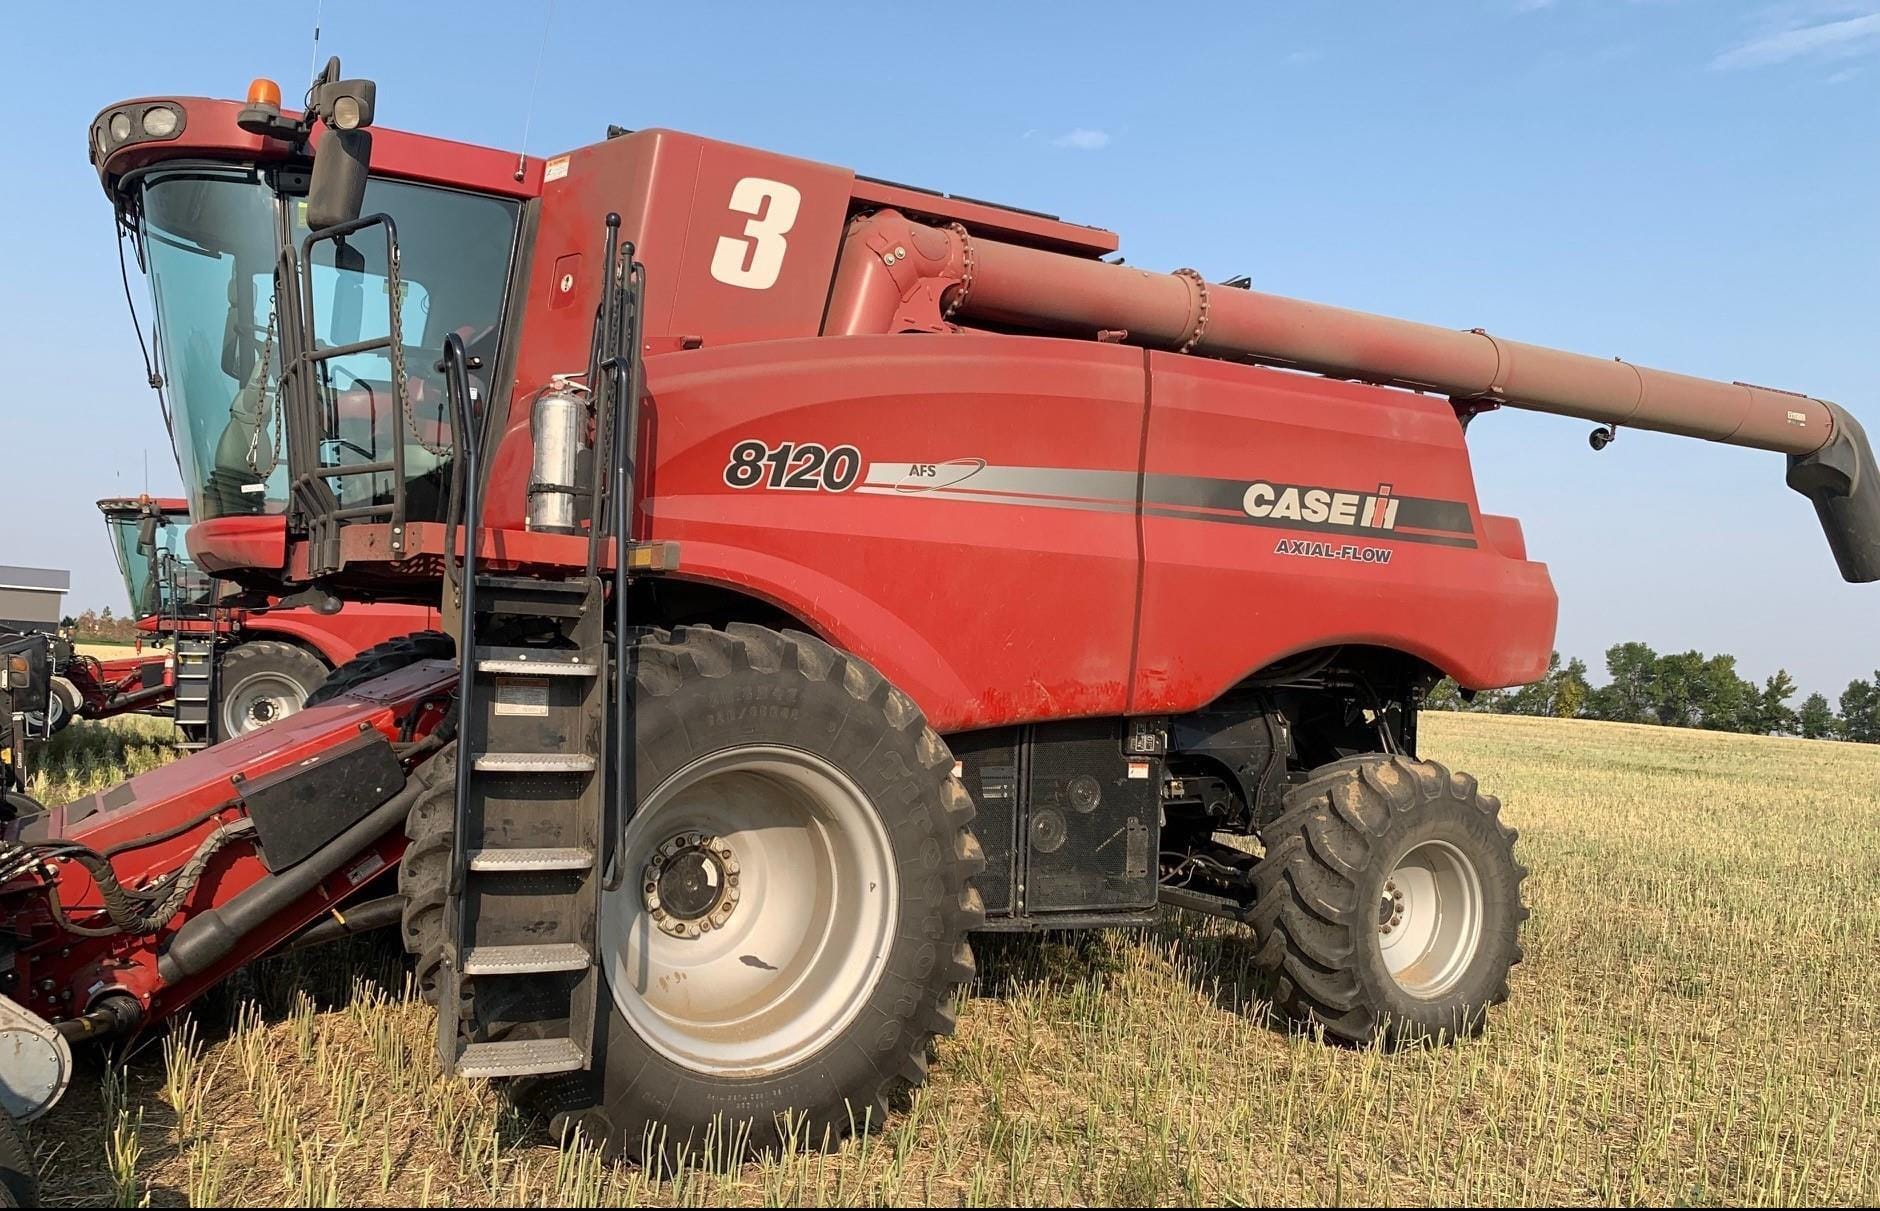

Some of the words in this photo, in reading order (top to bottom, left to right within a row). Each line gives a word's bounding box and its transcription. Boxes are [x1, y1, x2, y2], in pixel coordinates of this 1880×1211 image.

[711, 177, 801, 289] 3
[723, 440, 861, 491] 8120
[909, 464, 936, 477] AFS
[1243, 483, 1359, 525] CASE
[1275, 539, 1392, 563] AXIAL-FLOW
